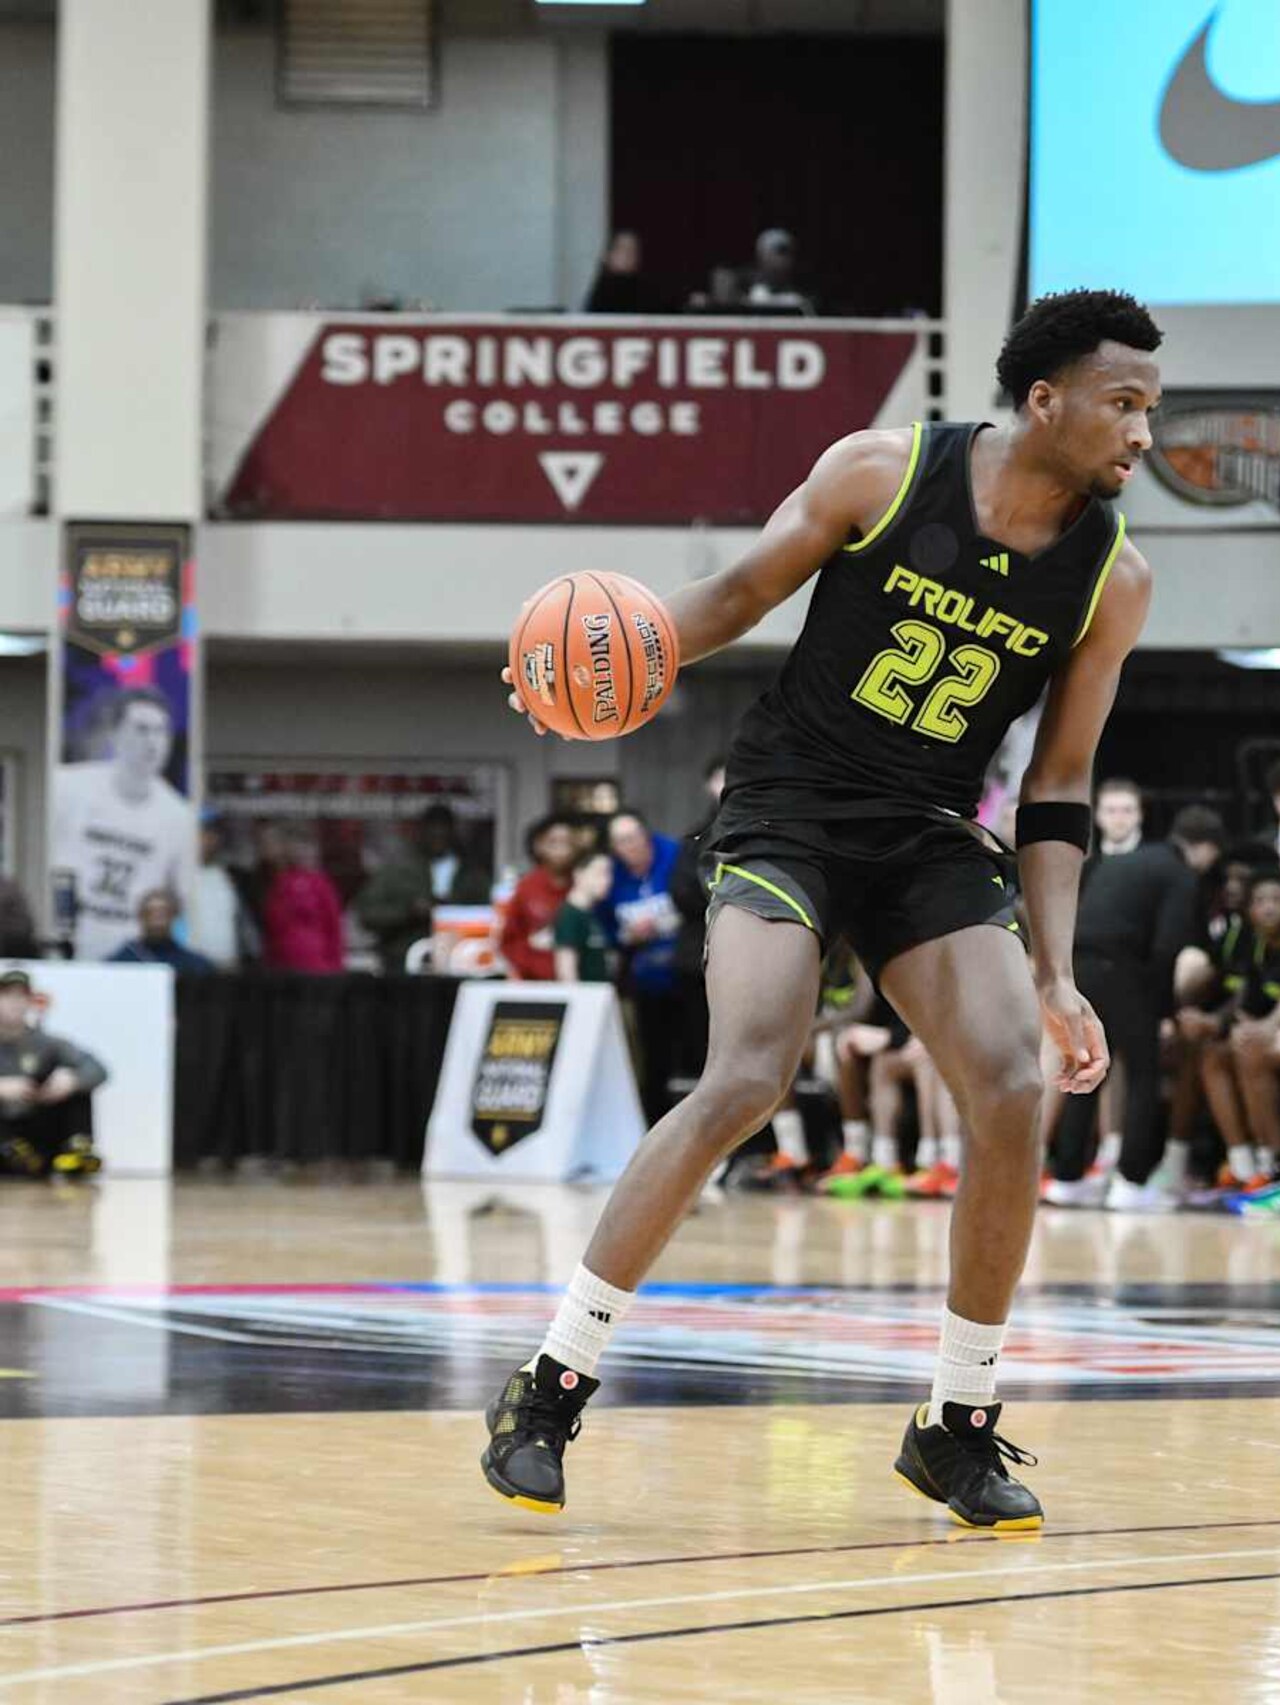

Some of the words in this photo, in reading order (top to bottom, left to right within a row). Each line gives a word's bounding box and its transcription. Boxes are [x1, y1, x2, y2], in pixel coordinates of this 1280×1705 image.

[321, 333, 827, 390] SPRINGFIELD
[444, 400, 701, 435] COLLEGE
[883, 564, 1050, 658] PROLIFIC
[582, 613, 619, 724] SPALDING
[631, 612, 658, 713] PRECISION
[850, 619, 1001, 743] 22
